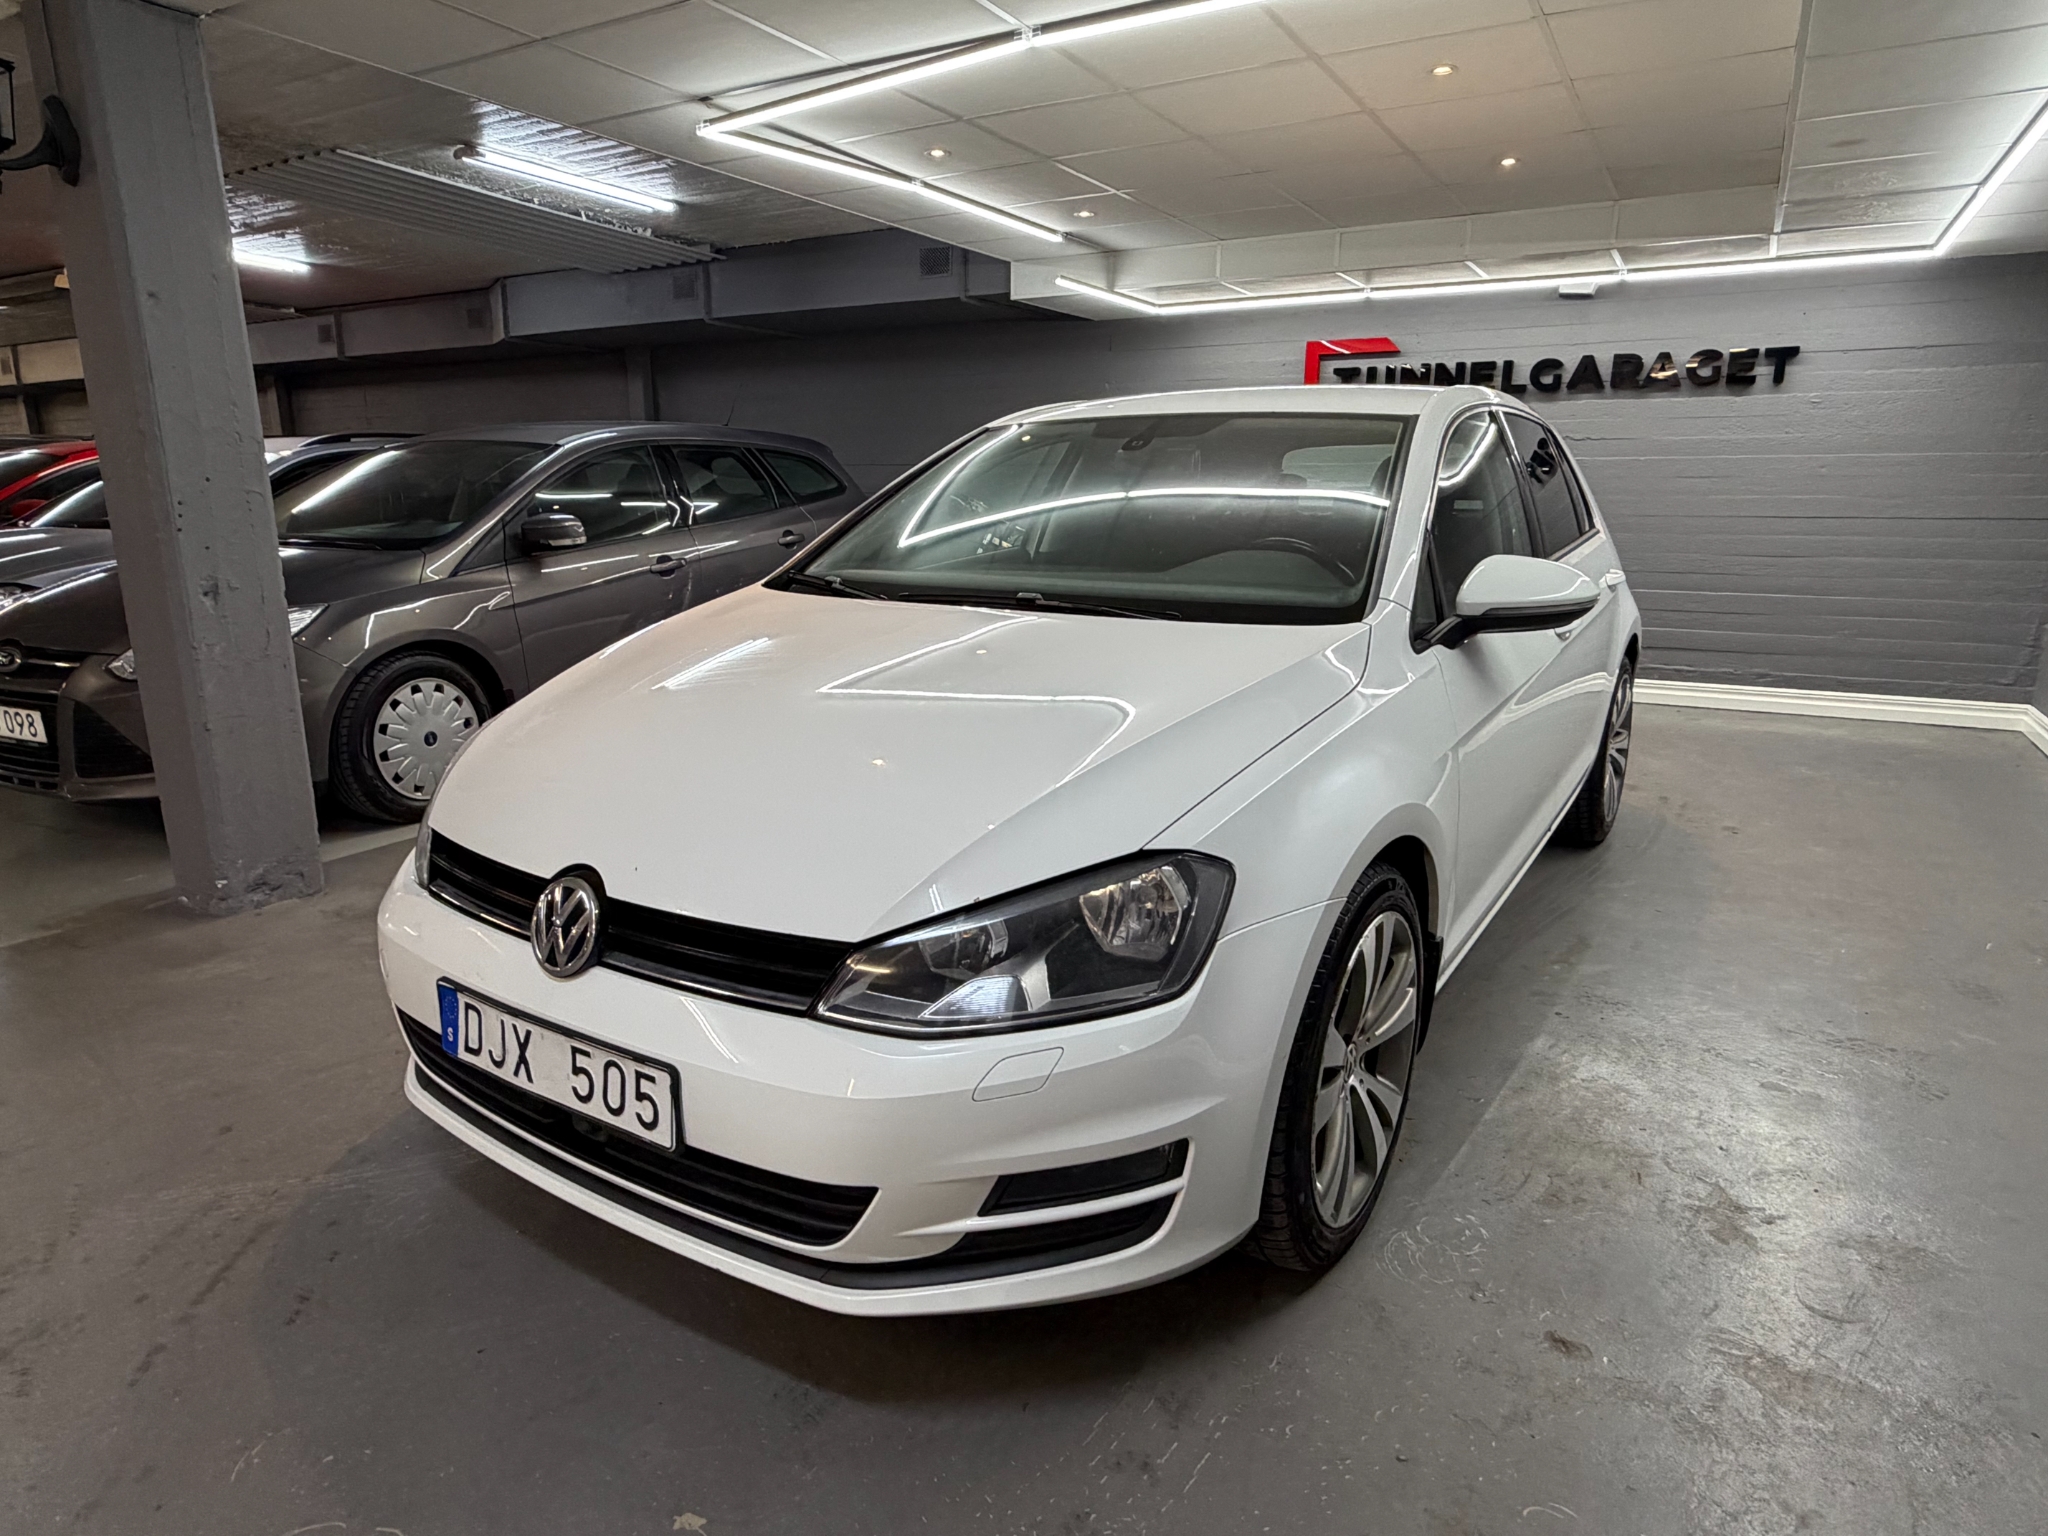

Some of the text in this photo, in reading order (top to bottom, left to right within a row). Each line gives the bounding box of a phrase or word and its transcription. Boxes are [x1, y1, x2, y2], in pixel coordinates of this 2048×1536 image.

[4, 710, 38, 738] 098
[447, 1027, 454, 1042] S
[464, 1001, 660, 1131] DJX 505
